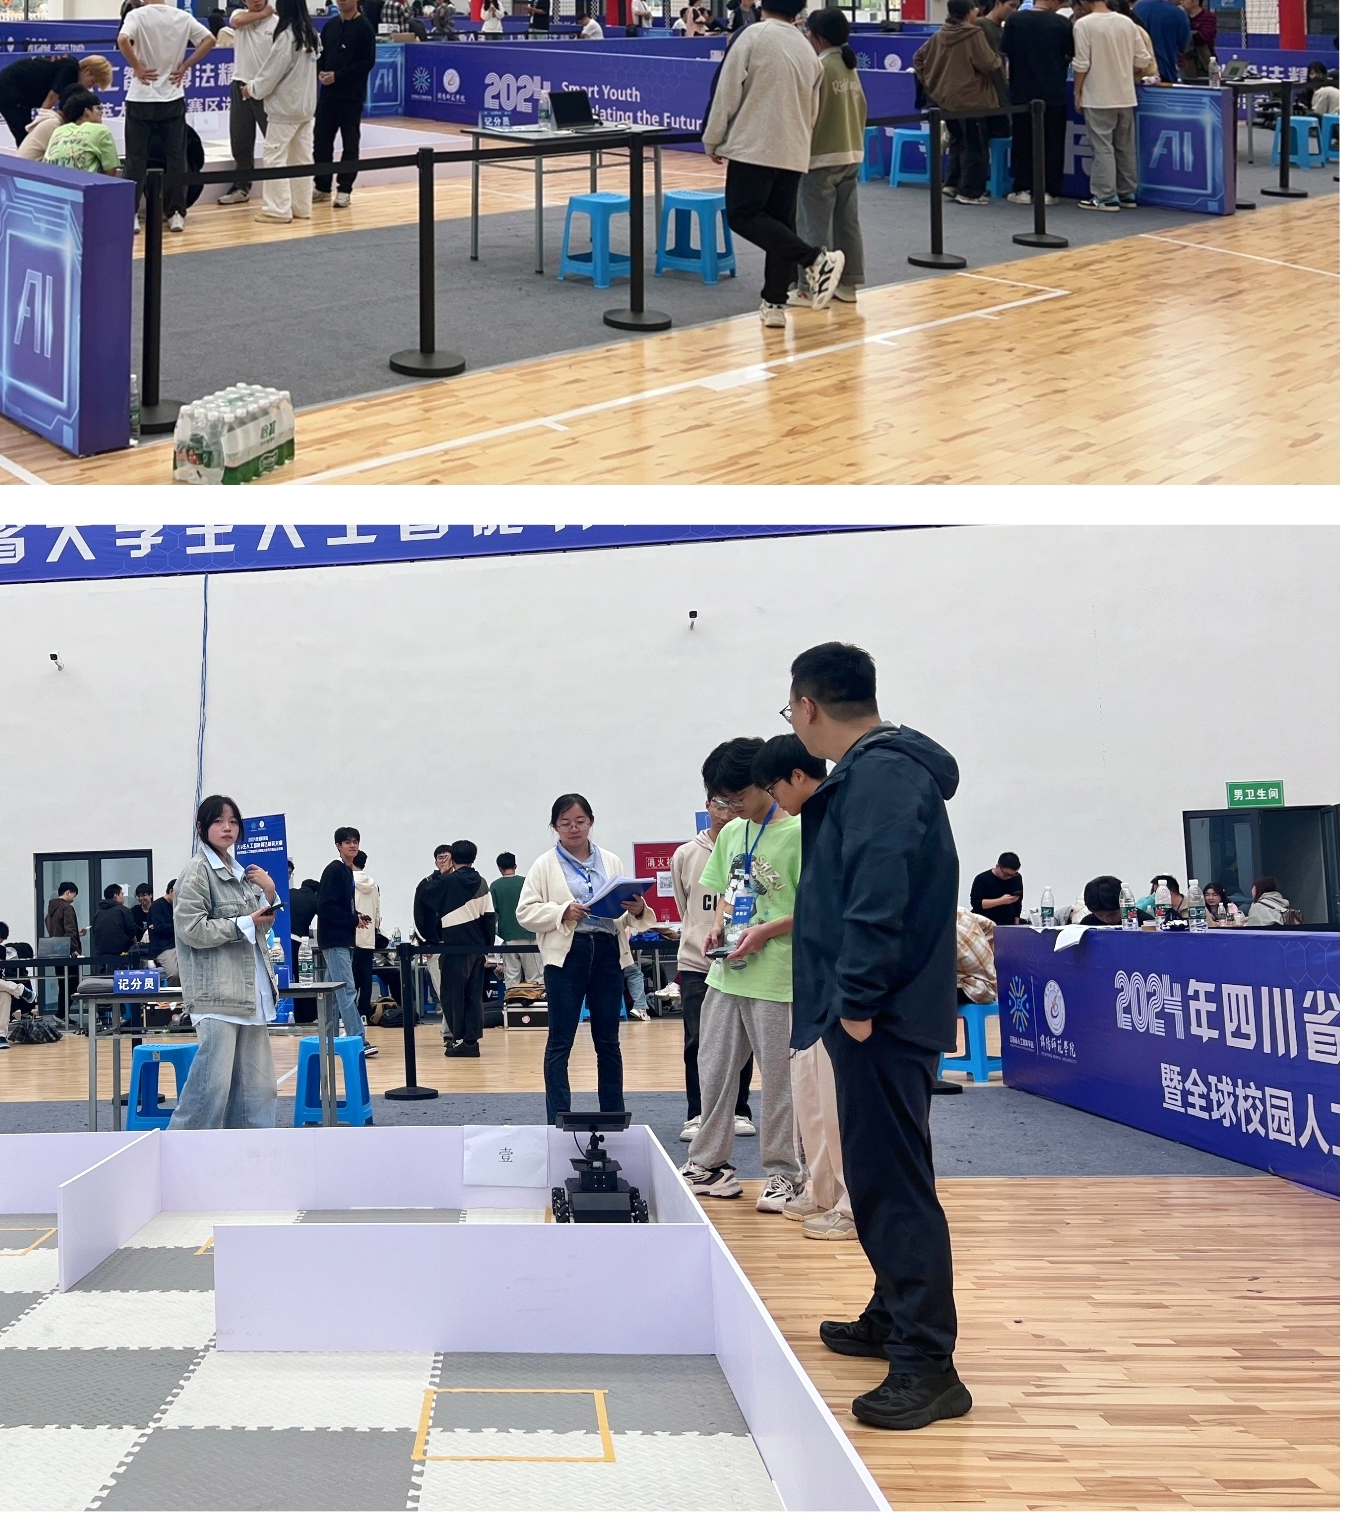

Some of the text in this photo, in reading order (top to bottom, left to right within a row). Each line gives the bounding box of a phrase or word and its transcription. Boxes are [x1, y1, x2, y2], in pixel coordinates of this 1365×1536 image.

[484, 72, 551, 113] 2024
[601, 85, 640, 102] Youth
[636, 110, 659, 127] the
[663, 113, 702, 131] Futur
[1149, 129, 1194, 172] AI
[14, 269, 54, 358] AI
[1232, 786, 1279, 803] 男卫生间
[118, 977, 155, 991] 记分员
[1114, 969, 1340, 1065] 2024年四川省
[498, 1147, 513, 1164] 壹
